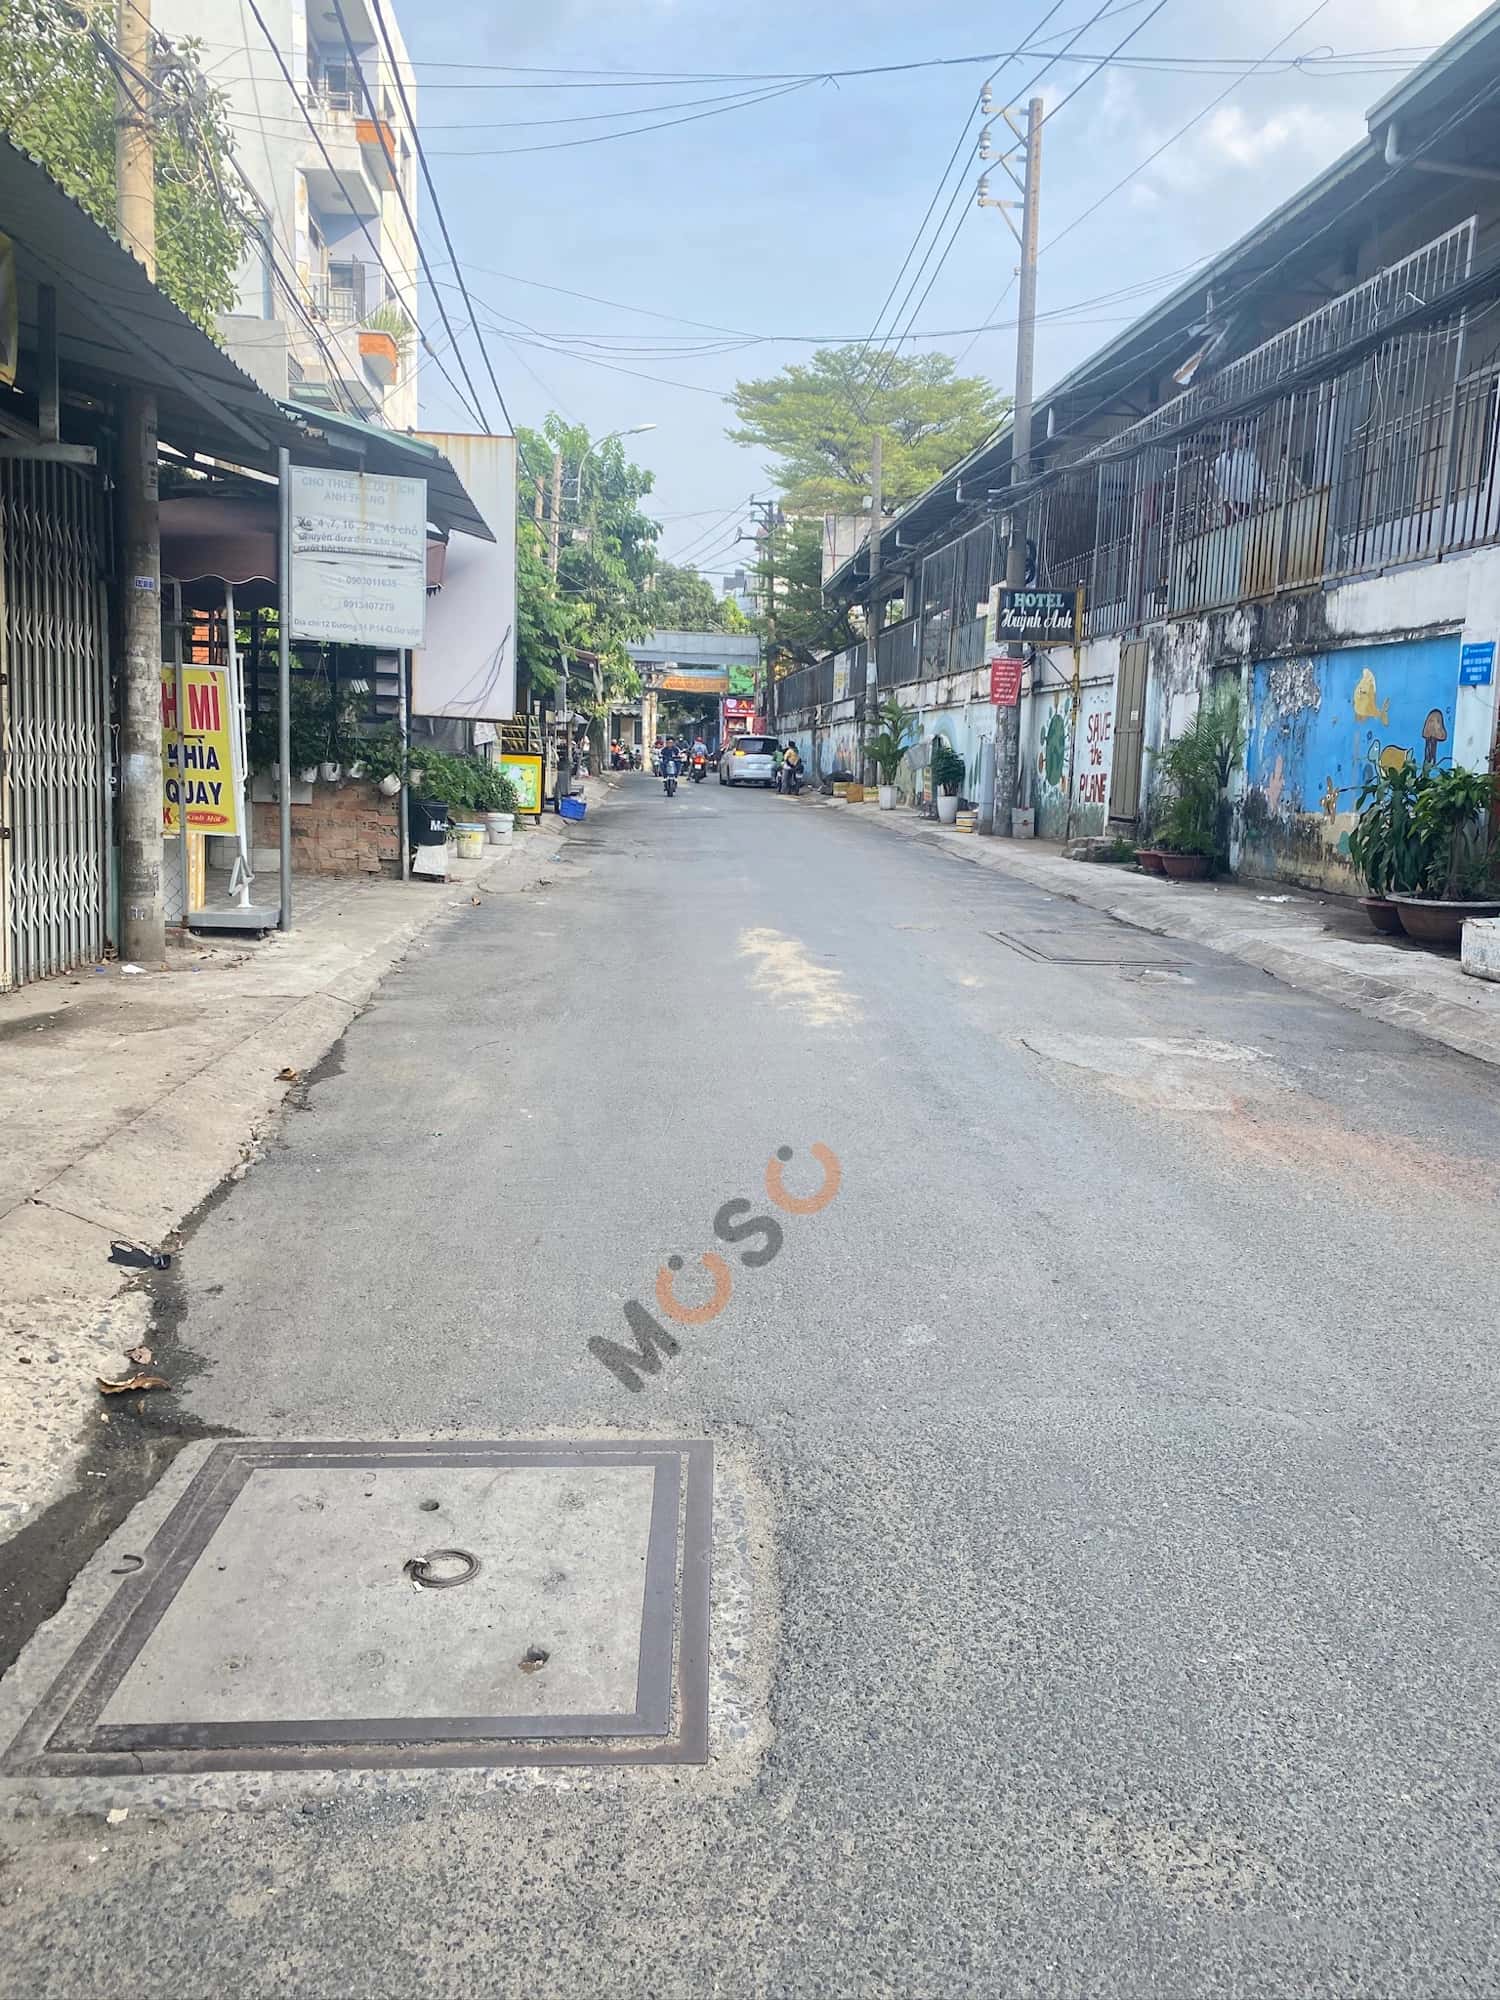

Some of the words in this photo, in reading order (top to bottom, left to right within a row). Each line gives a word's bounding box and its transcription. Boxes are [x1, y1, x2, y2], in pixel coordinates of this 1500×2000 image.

[1014, 592, 1065, 608] HOTEL
[1043, 608, 1073, 629] Anh
[187, 671, 221, 731] MÌ
[1086, 711, 1112, 743] SAVE
